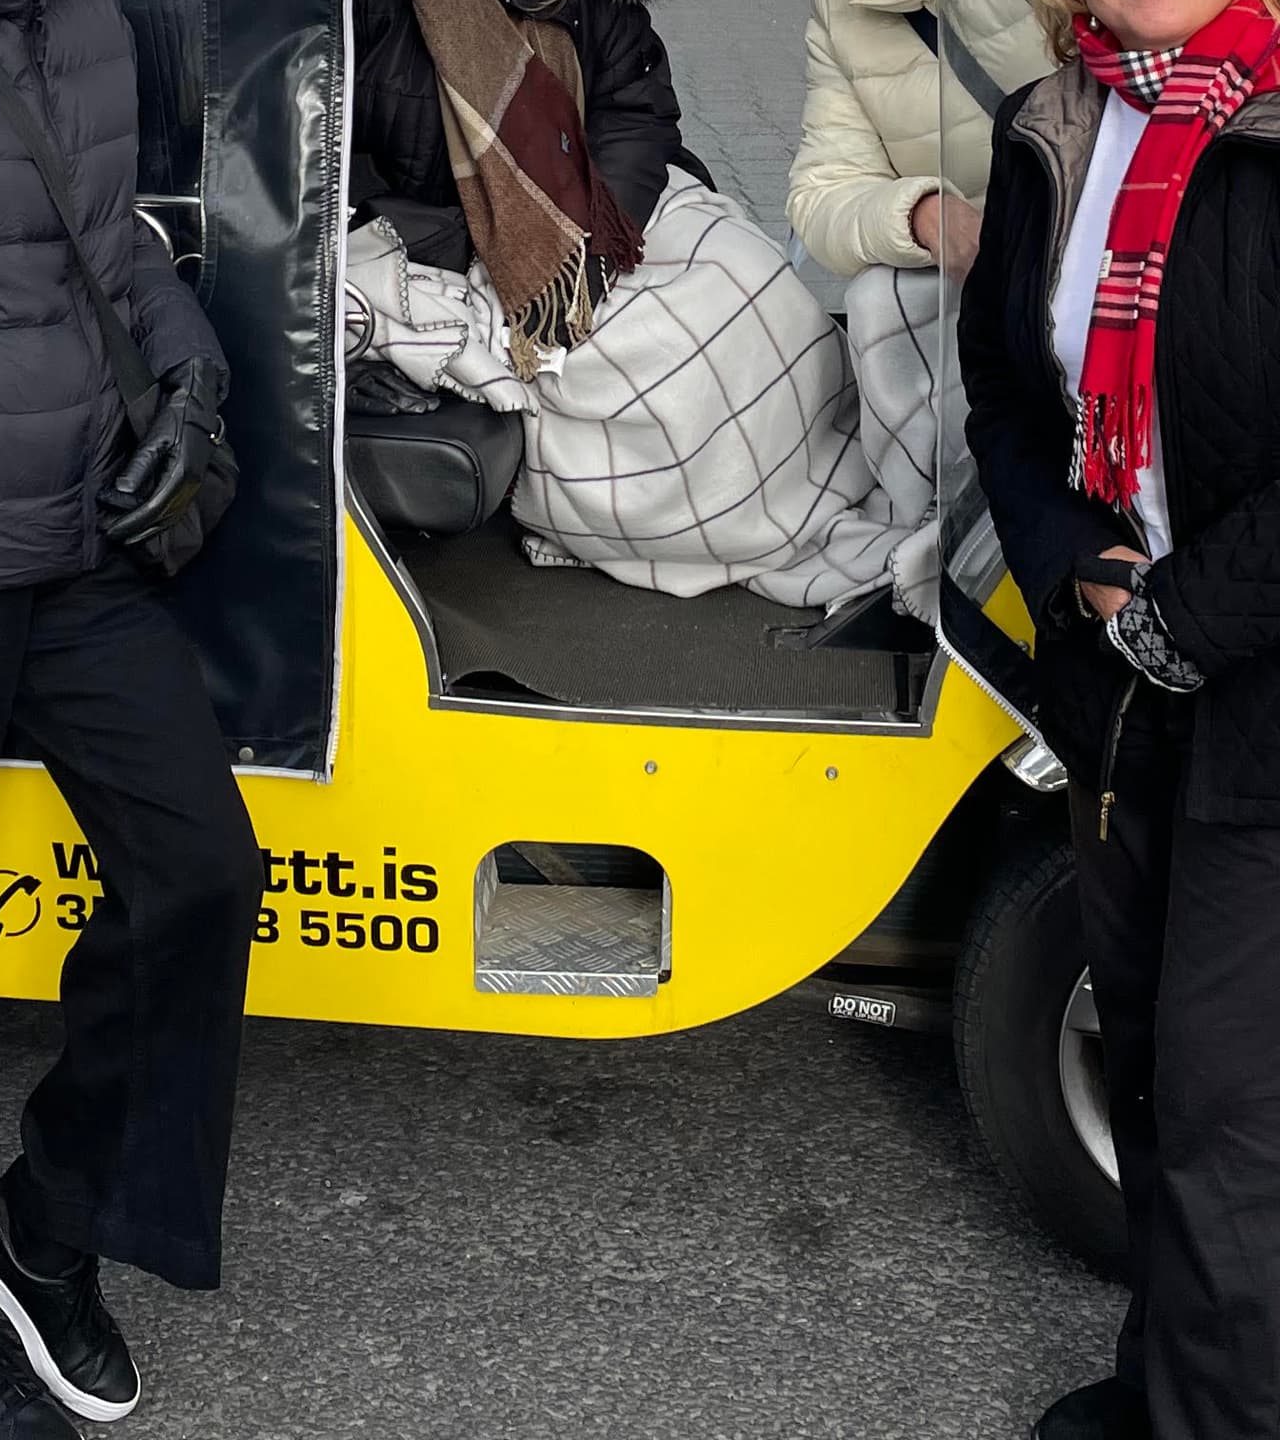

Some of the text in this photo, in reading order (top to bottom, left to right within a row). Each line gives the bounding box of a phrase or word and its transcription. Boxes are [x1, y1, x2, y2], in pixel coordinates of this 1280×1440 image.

[300, 910, 439, 953] 5500
[833, 997, 891, 1019] DO NOT
